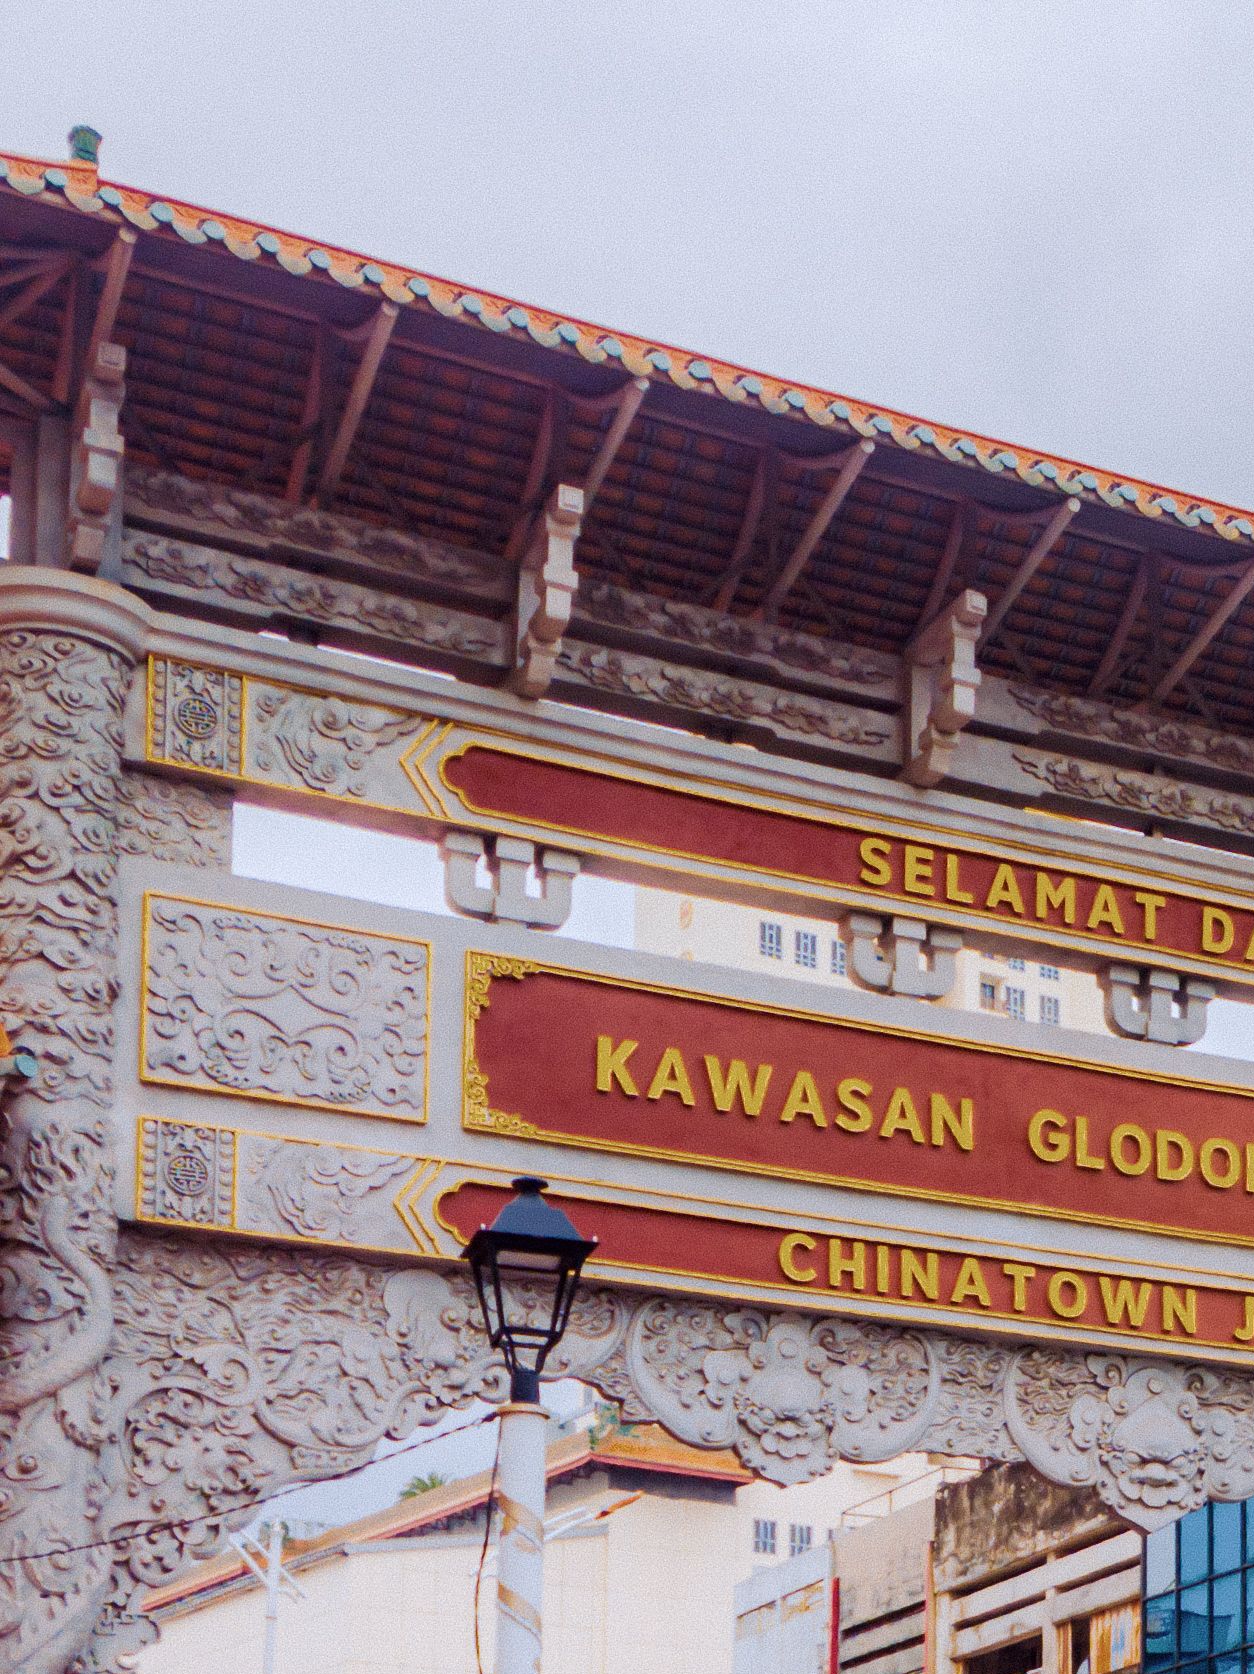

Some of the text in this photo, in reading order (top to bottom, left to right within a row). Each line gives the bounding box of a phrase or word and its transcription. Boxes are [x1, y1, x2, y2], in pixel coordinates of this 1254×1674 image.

[859, 836, 1166, 941] SELAMAT
[594, 1034, 975, 1151] KAWASAN
[778, 1233, 1198, 1334] CHINATOWN
